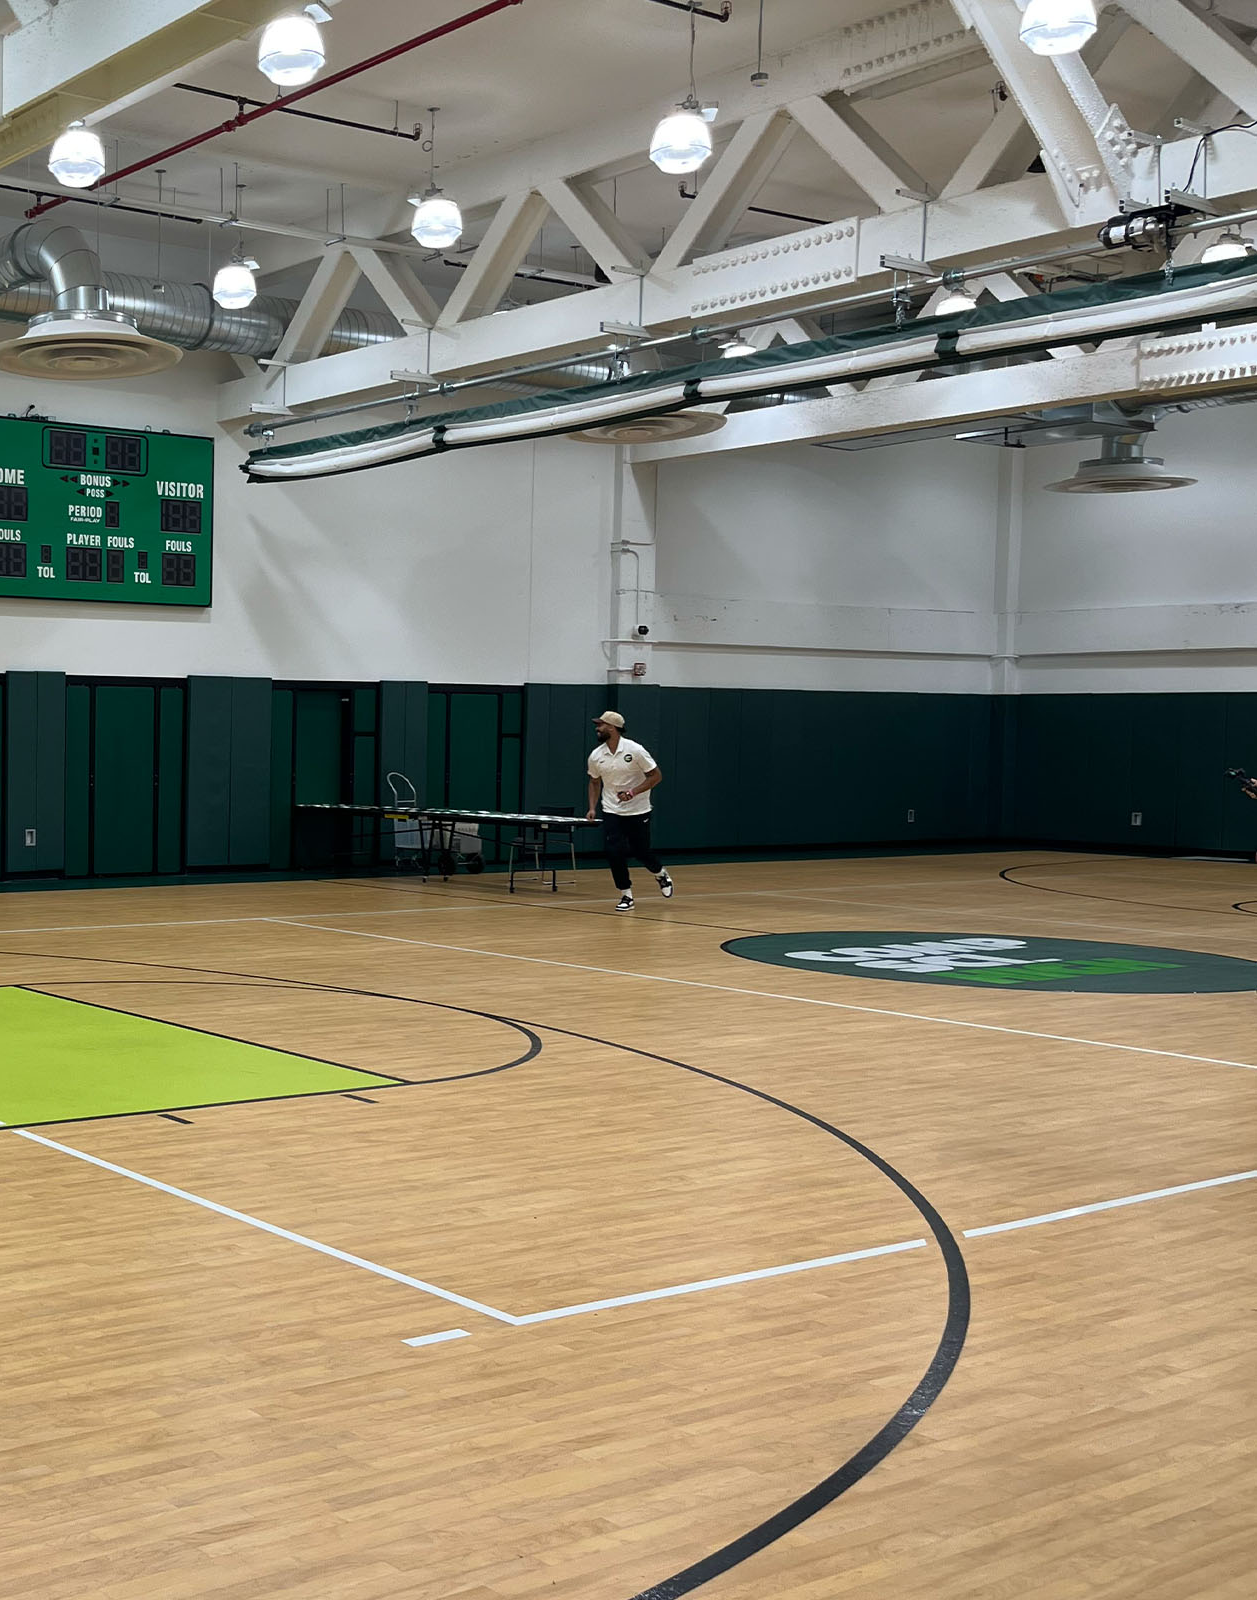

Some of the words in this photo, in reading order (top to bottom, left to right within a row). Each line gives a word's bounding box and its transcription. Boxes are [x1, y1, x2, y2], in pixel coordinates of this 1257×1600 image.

[80, 474, 111, 487] BONUS
[86, 488, 105, 498] POSS
[156, 480, 204, 499] VISITOR
[68, 504, 103, 518] PERIOD
[66, 533, 101, 546] PLAYER
[107, 536, 135, 549] FOULS
[165, 540, 192, 552] FOULS
[37, 566, 55, 578] TOL
[133, 571, 152, 584] TOL
[784, 937, 1028, 962] COMP
[926, 957, 1186, 985] HIGH
